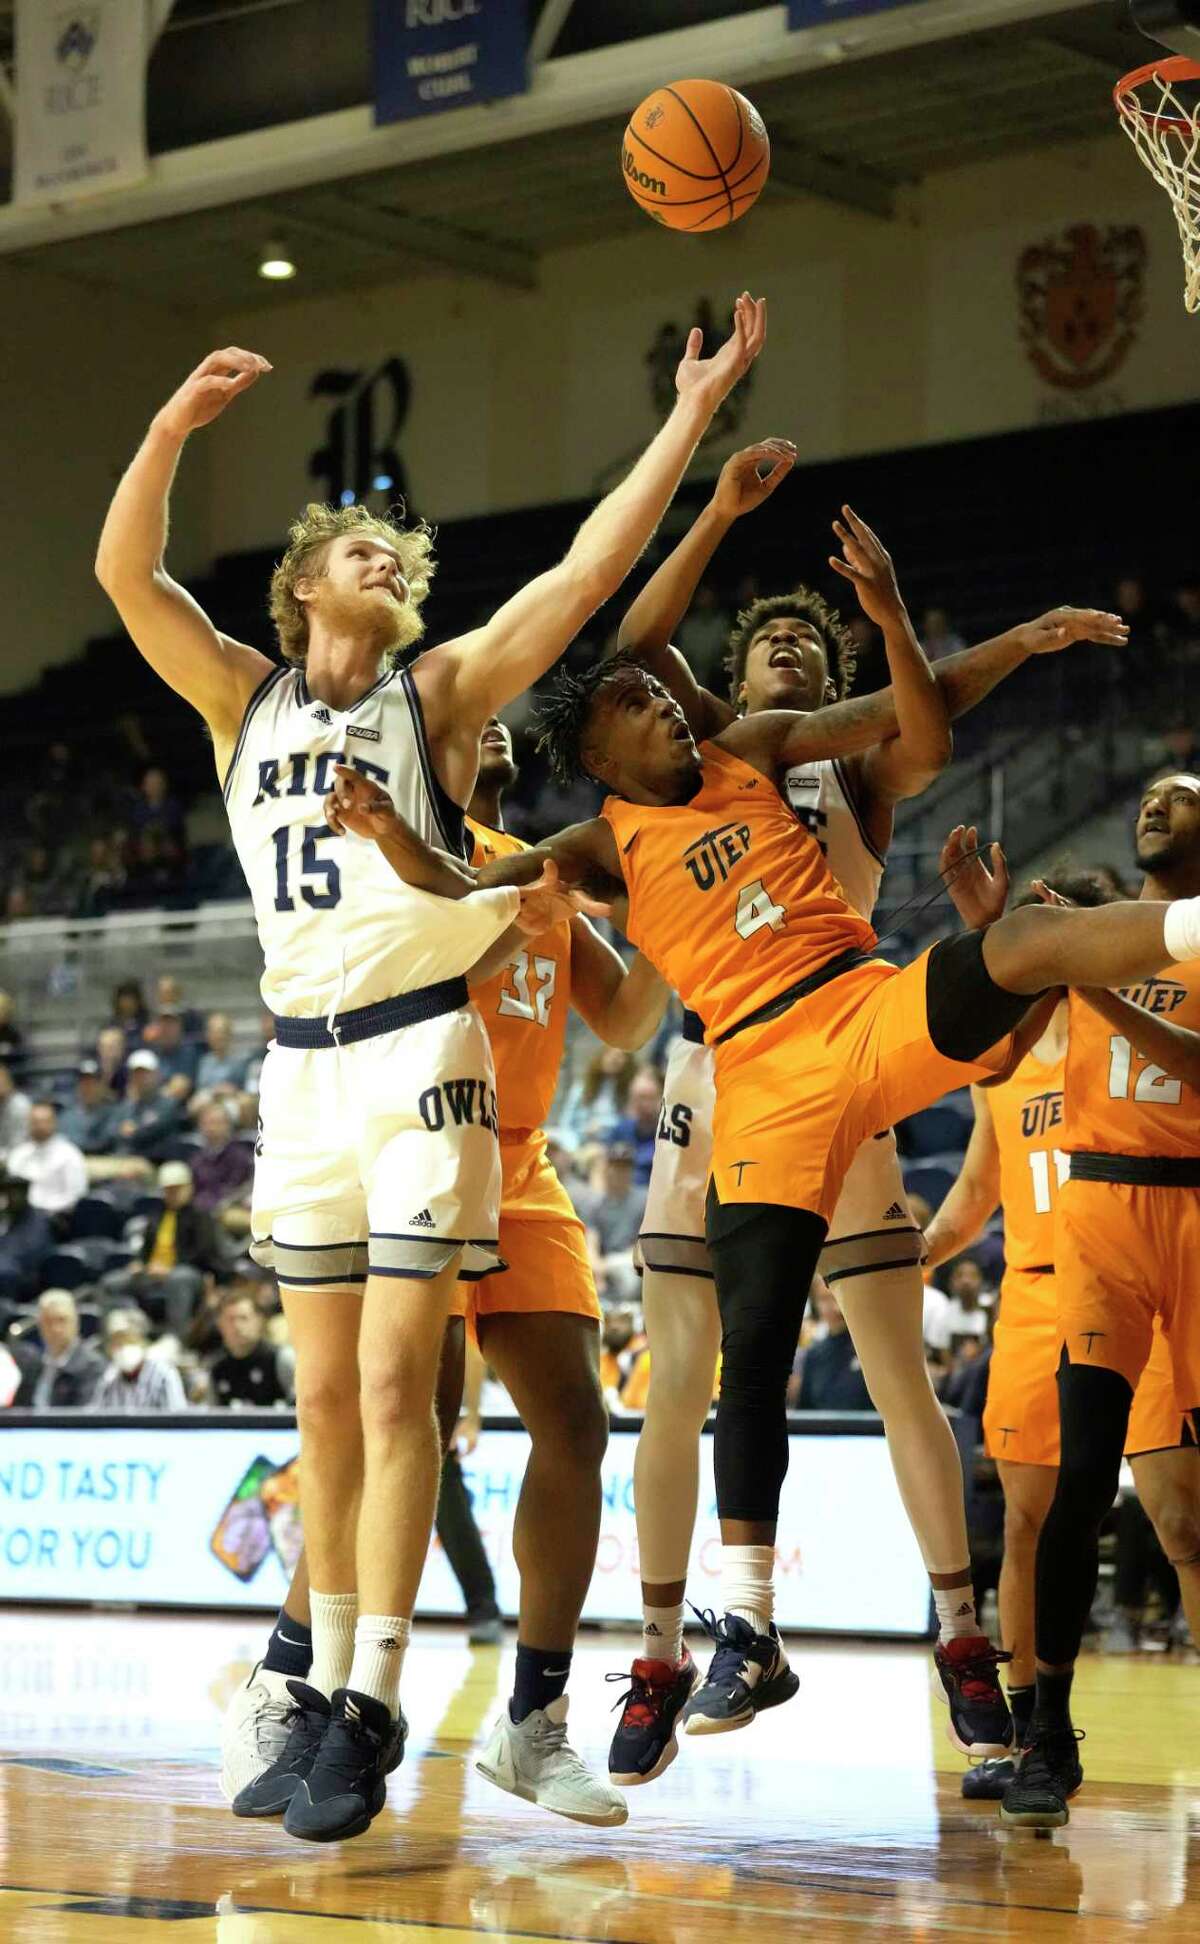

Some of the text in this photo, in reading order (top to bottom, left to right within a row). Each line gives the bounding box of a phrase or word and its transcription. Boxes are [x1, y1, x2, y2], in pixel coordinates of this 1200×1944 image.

[272, 825, 341, 912] 15
[684, 822, 750, 891] UTEP
[735, 878, 788, 941] 4
[58, 1460, 167, 1502] TASTY
[72, 1528, 152, 1569] YOU
